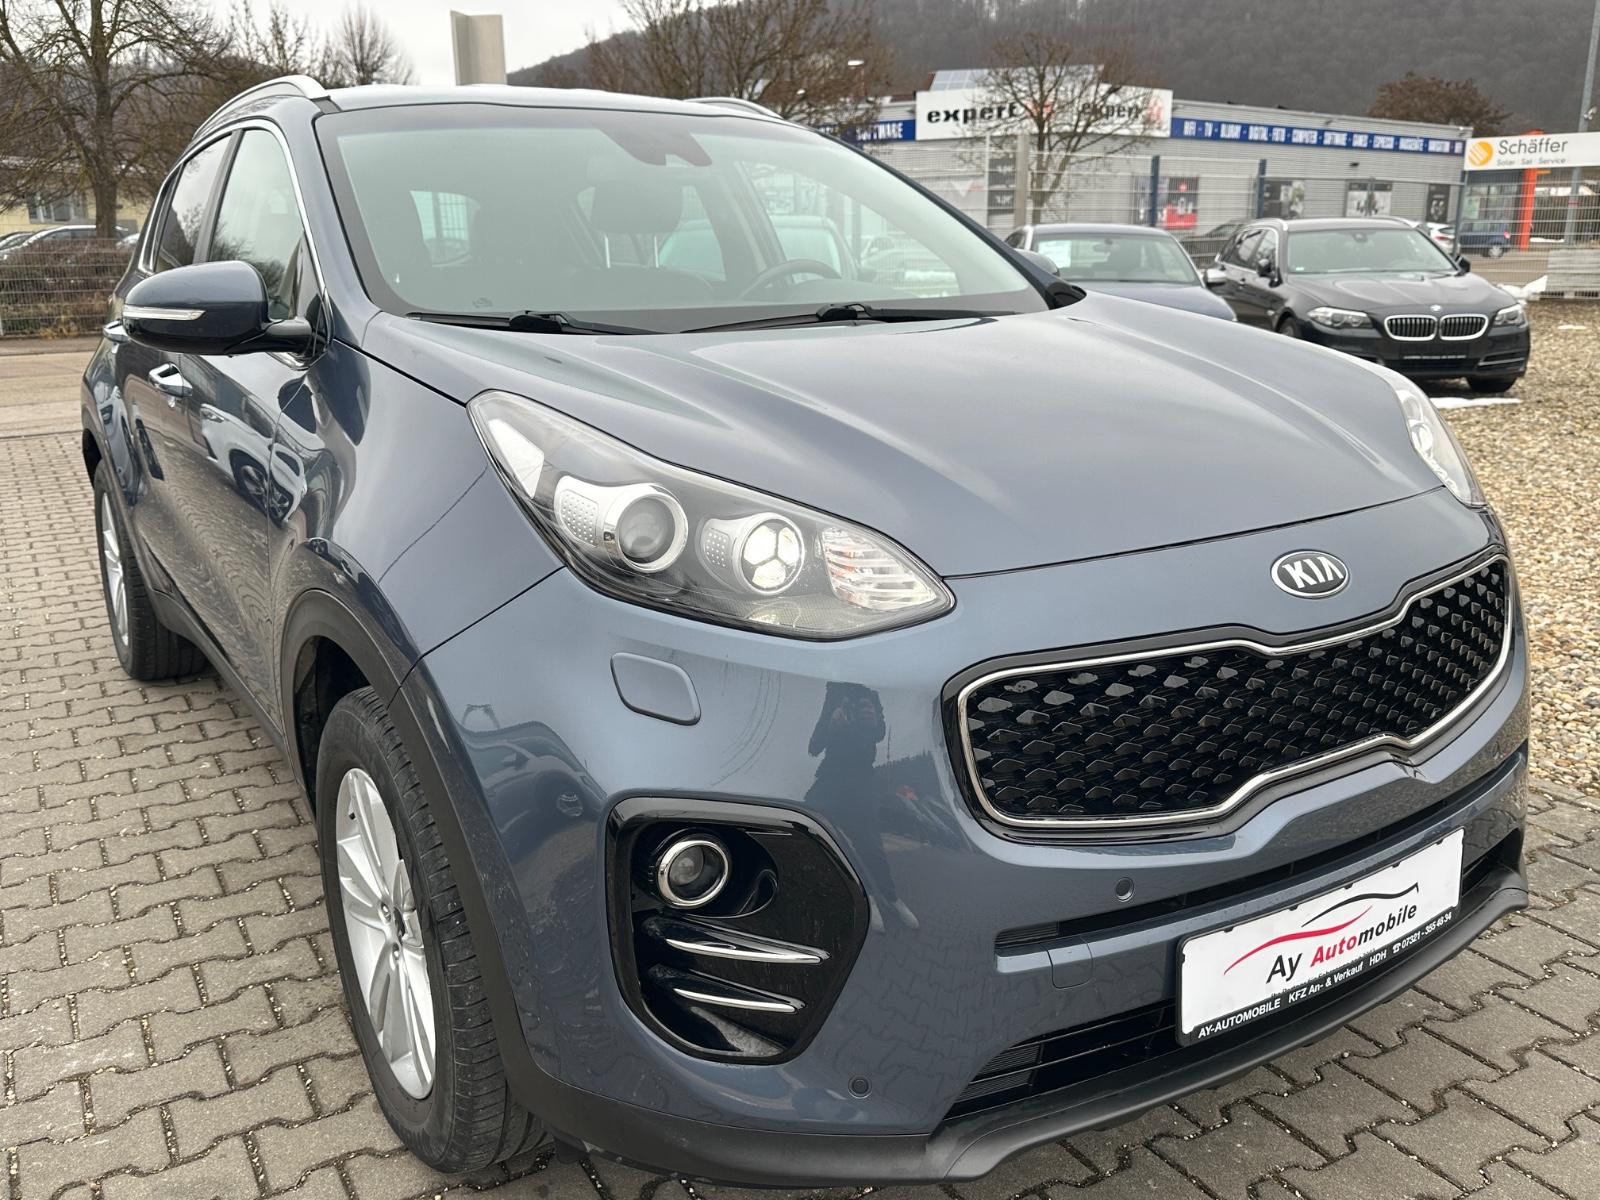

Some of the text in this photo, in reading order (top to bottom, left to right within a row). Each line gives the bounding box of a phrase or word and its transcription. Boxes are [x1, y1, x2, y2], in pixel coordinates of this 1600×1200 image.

[927, 101, 1019, 124] expert
[1498, 138, 1568, 155] Schäffer
[1282, 556, 1344, 589] KIA
[1266, 904, 1417, 984] Ay Automobile
[1198, 998, 1281, 1039] AY-AUTOMOBILE
[1288, 987, 1308, 1004] KFZ
[1308, 984, 1324, 996] An-
[1325, 977, 1332, 987] &
[1333, 961, 1364, 983] Verkauf
[1369, 949, 1387, 967] HDH
[1401, 930, 1421, 949] 07321
